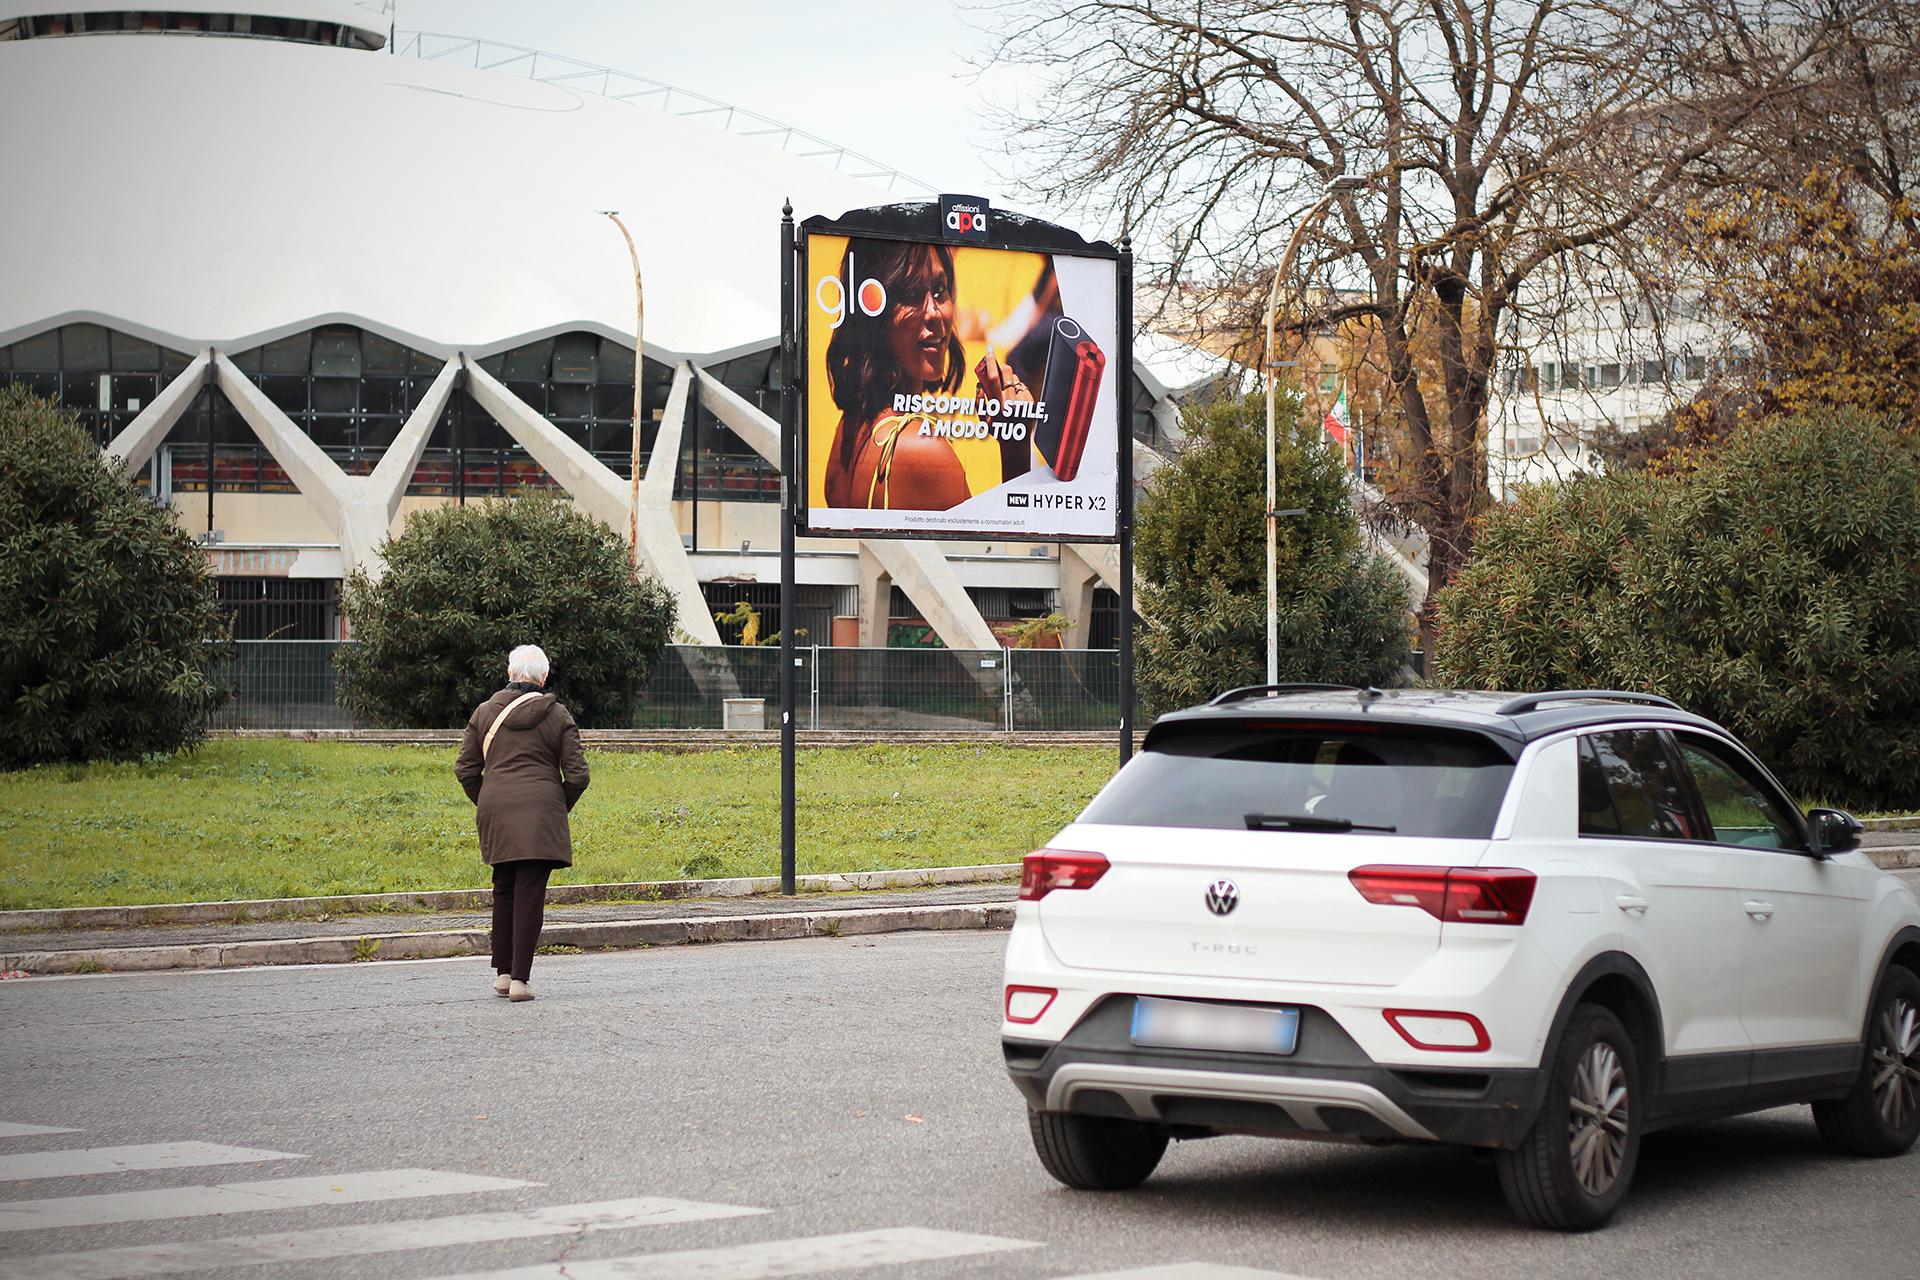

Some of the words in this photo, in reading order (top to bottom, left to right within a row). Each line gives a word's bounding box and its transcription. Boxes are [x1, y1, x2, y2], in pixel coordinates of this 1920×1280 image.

[952, 204, 980, 213] affissioni
[946, 211, 986, 233] apa
[816, 251, 887, 329] glo
[893, 394, 976, 416] RISCOPRI
[978, 398, 1000, 416] LO
[1003, 400, 1049, 423] STILE,
[918, 419, 931, 436] A
[934, 419, 989, 439] MODO
[992, 421, 1027, 441] TUO
[1009, 496, 1028, 505] NEW
[1033, 494, 1083, 510] HYPER
[1088, 496, 1106, 511] X2
